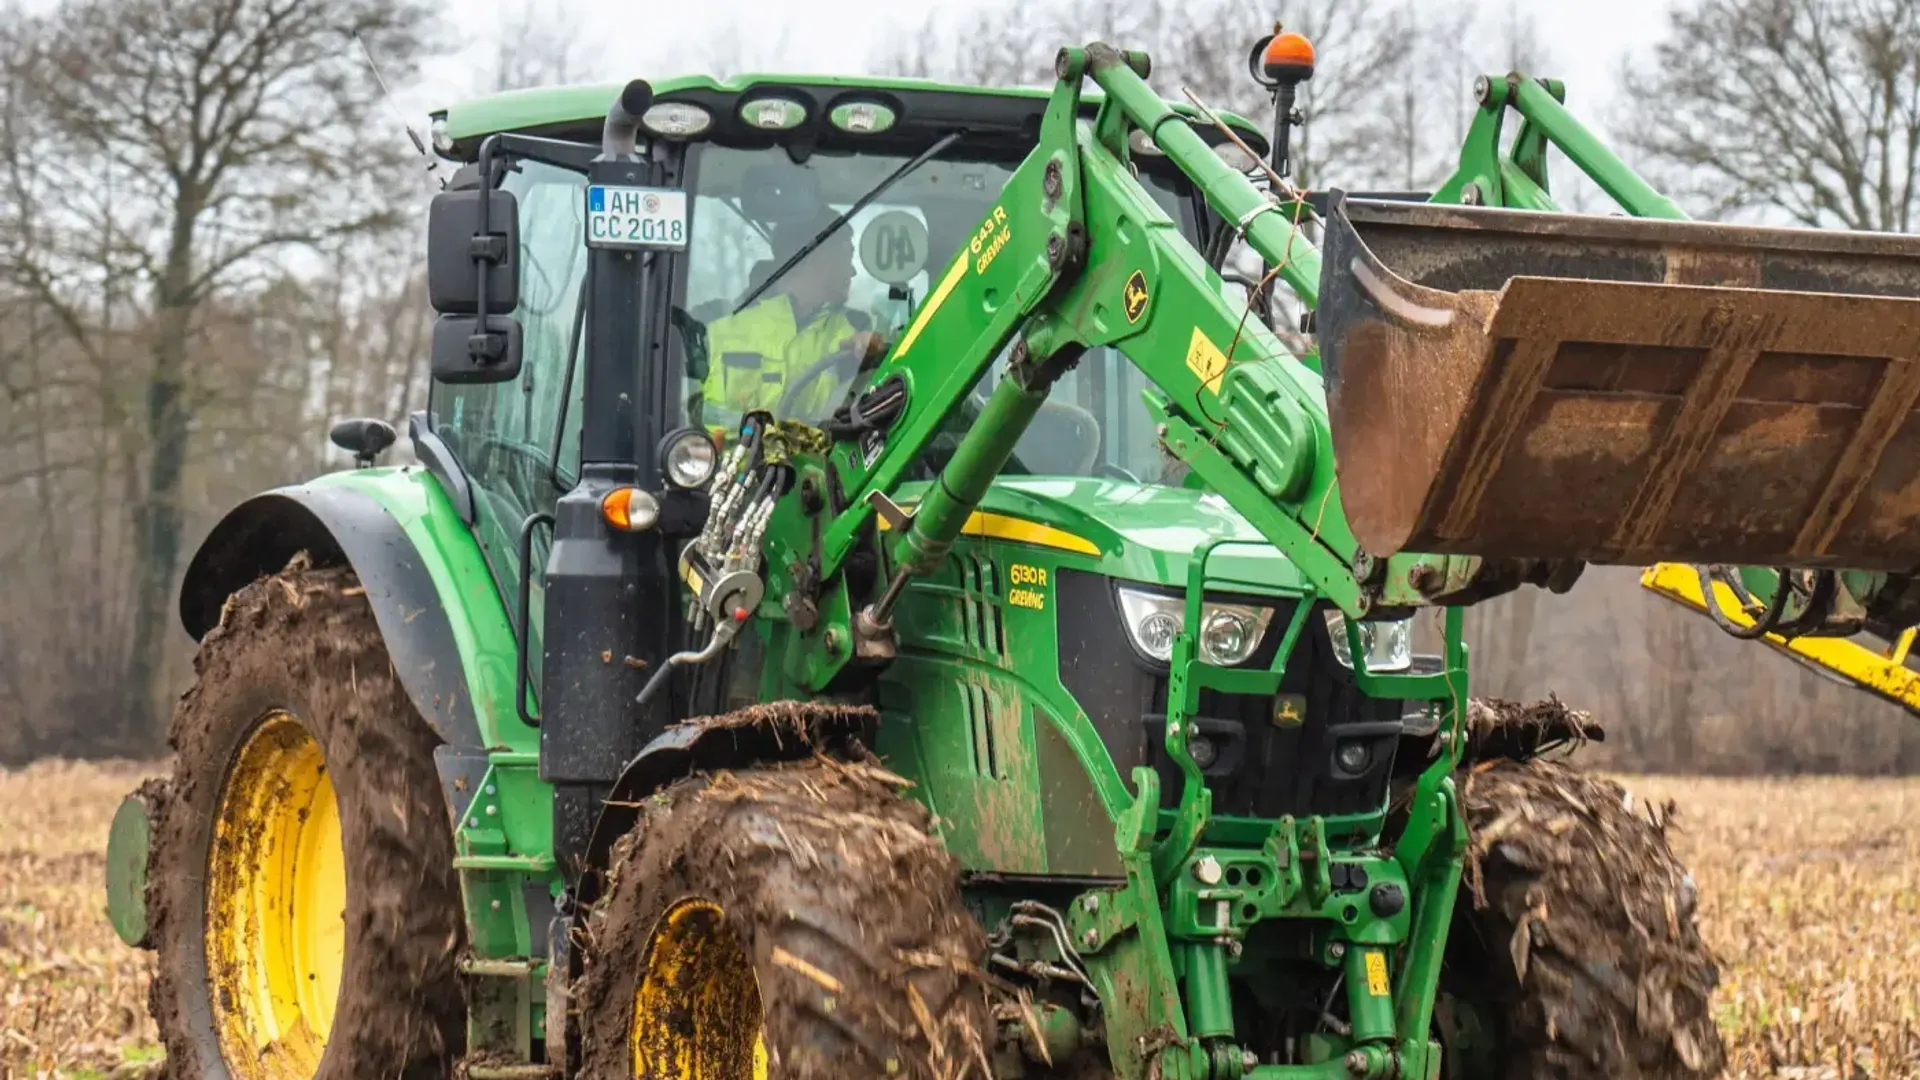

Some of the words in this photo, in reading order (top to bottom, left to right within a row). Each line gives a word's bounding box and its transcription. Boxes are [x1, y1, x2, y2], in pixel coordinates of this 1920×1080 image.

[611, 191, 640, 215] AH
[593, 216, 622, 238] CC
[628, 218, 682, 242] 2018
[970, 220, 995, 254] 643
[993, 205, 1007, 225] R
[1010, 563, 1037, 585] 6130
[1038, 567, 1047, 587] R
